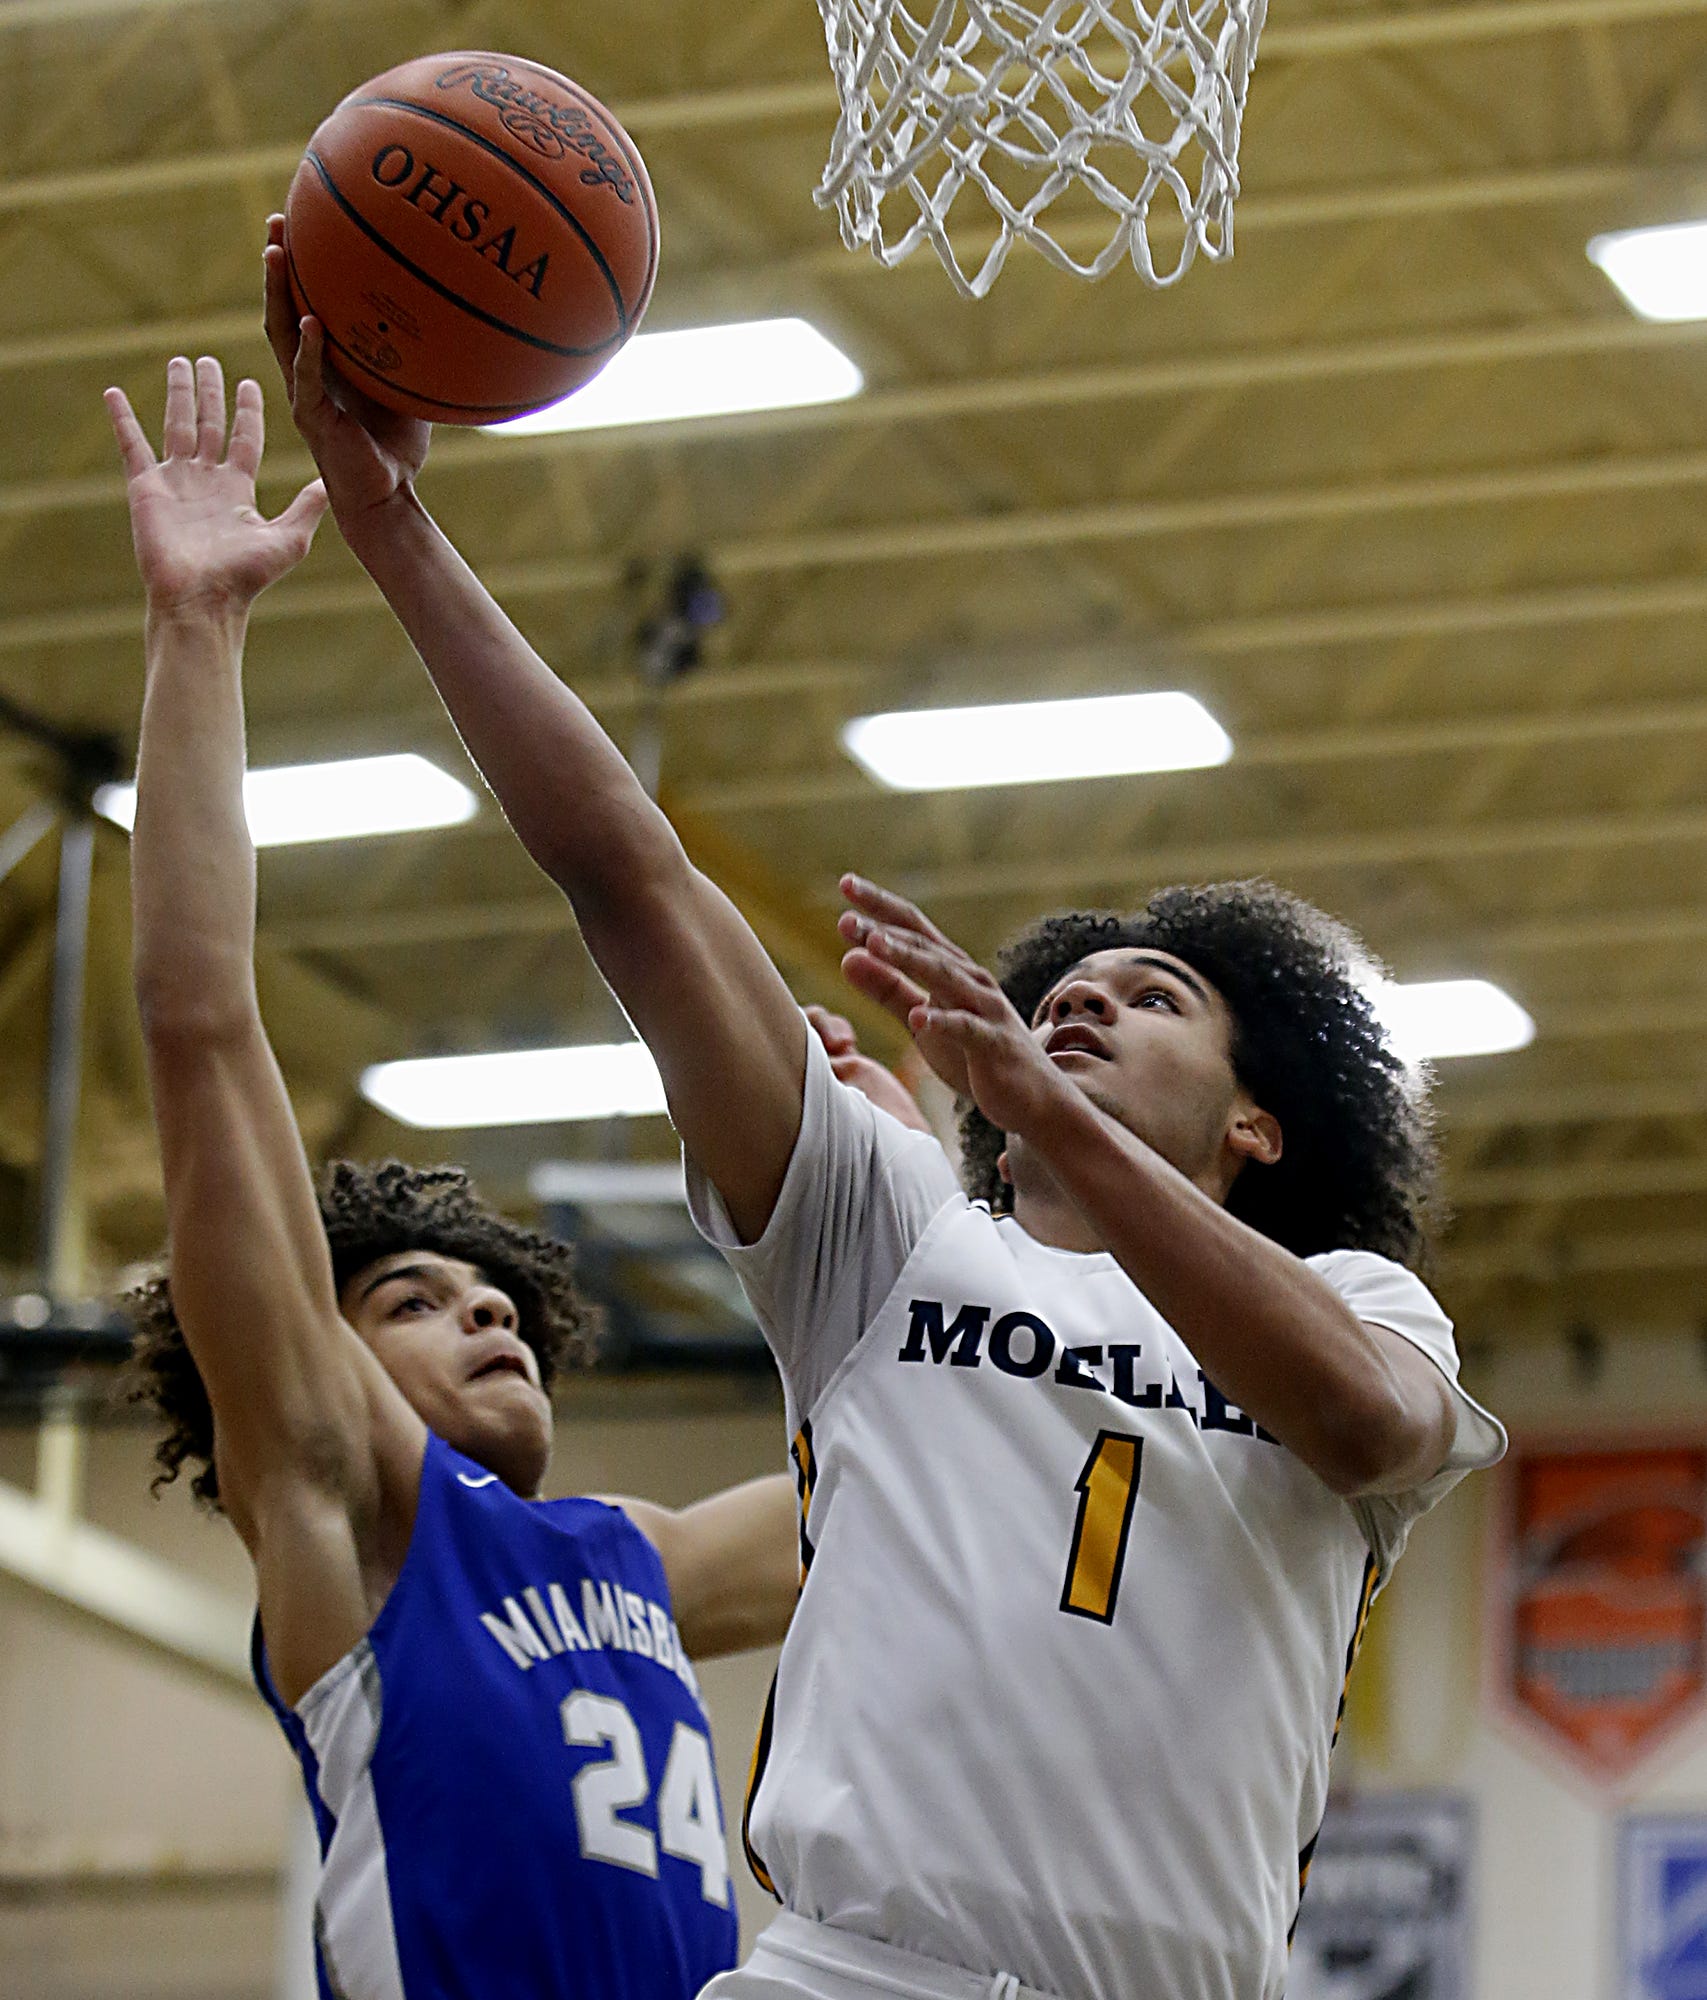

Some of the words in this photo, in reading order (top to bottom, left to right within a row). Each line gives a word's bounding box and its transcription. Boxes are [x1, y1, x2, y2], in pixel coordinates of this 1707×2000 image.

[372, 144, 551, 298] OHSAA
[436, 64, 633, 205] Rawlings
[1059, 1429, 1144, 1626] 1
[560, 1688, 729, 1911] 24
